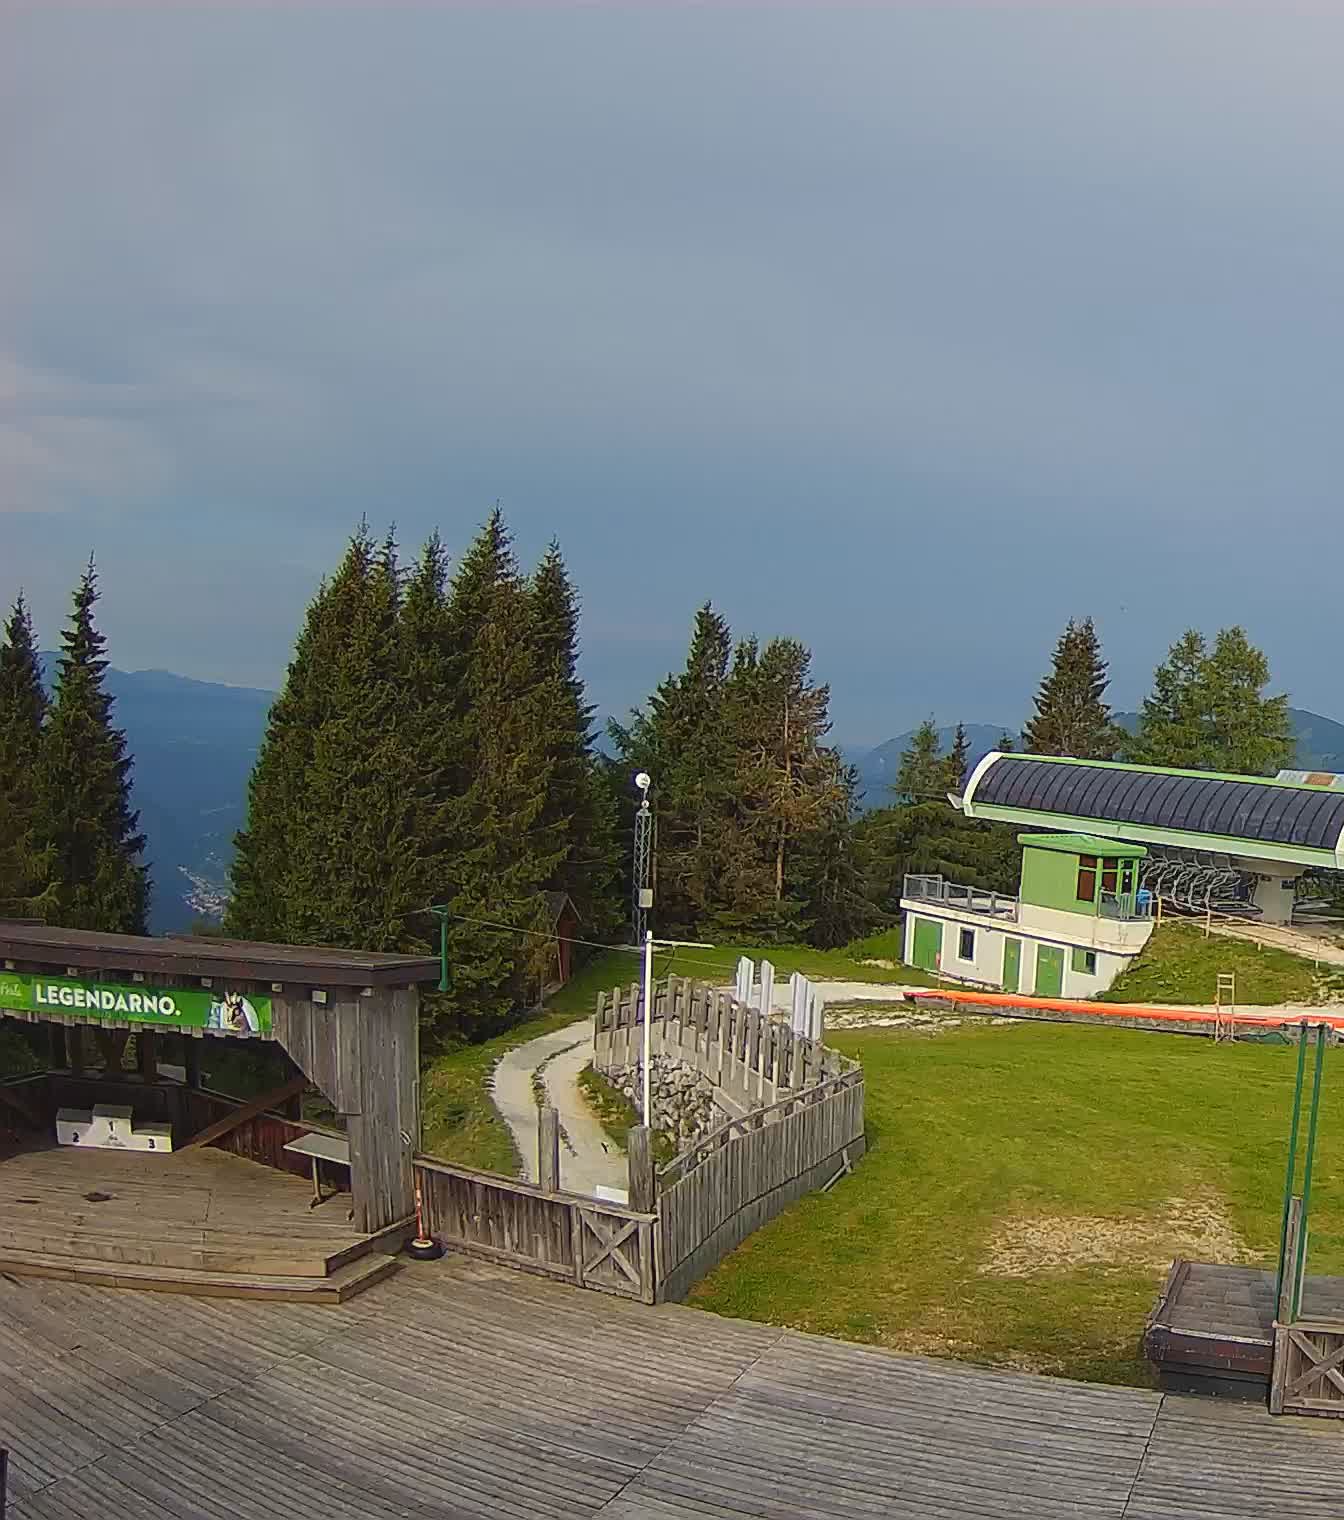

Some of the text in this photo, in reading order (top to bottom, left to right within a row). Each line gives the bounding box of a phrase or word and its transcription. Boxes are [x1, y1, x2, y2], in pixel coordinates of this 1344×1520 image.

[36, 983, 182, 1017] LEGENDARNO.
[108, 1120, 114, 1132] 1
[72, 1132, 80, 1143] 2
[148, 1138, 156, 1149] 3
